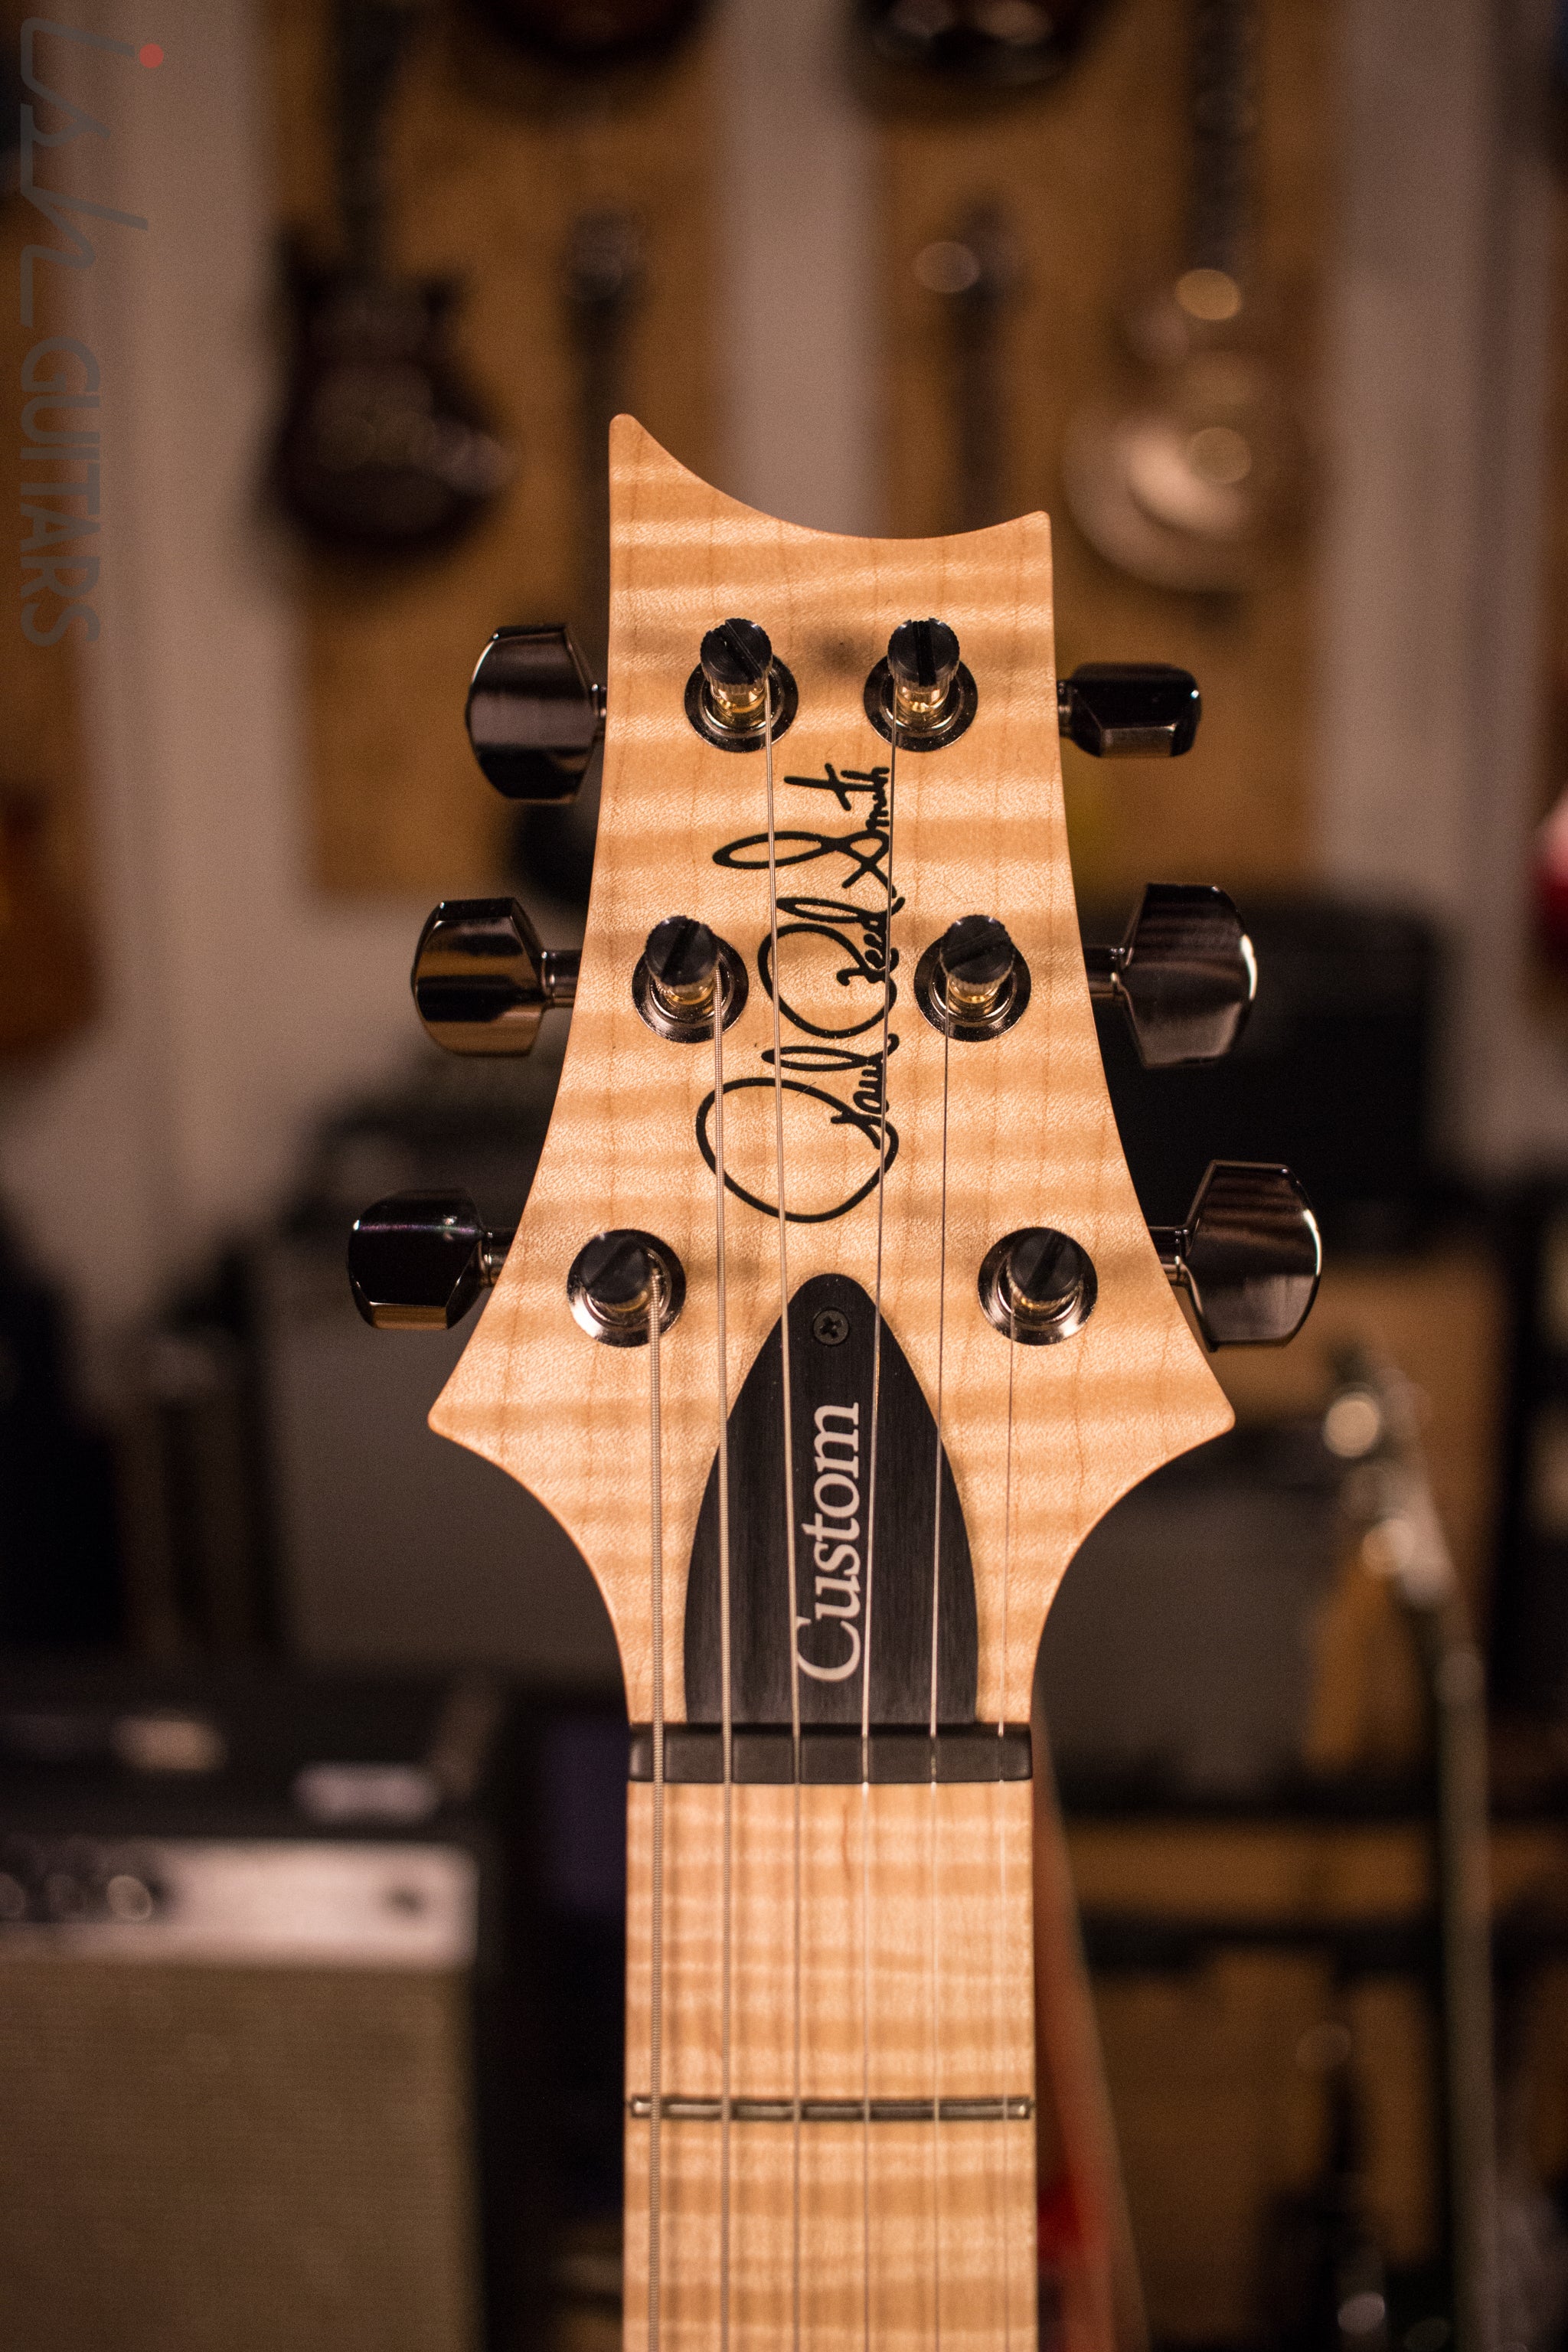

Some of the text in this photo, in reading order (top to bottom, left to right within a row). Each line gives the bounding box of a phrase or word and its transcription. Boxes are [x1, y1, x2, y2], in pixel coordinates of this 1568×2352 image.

[695, 763, 906, 1223] Paul Reed Smith
[796, 1402, 861, 1682] Custom
